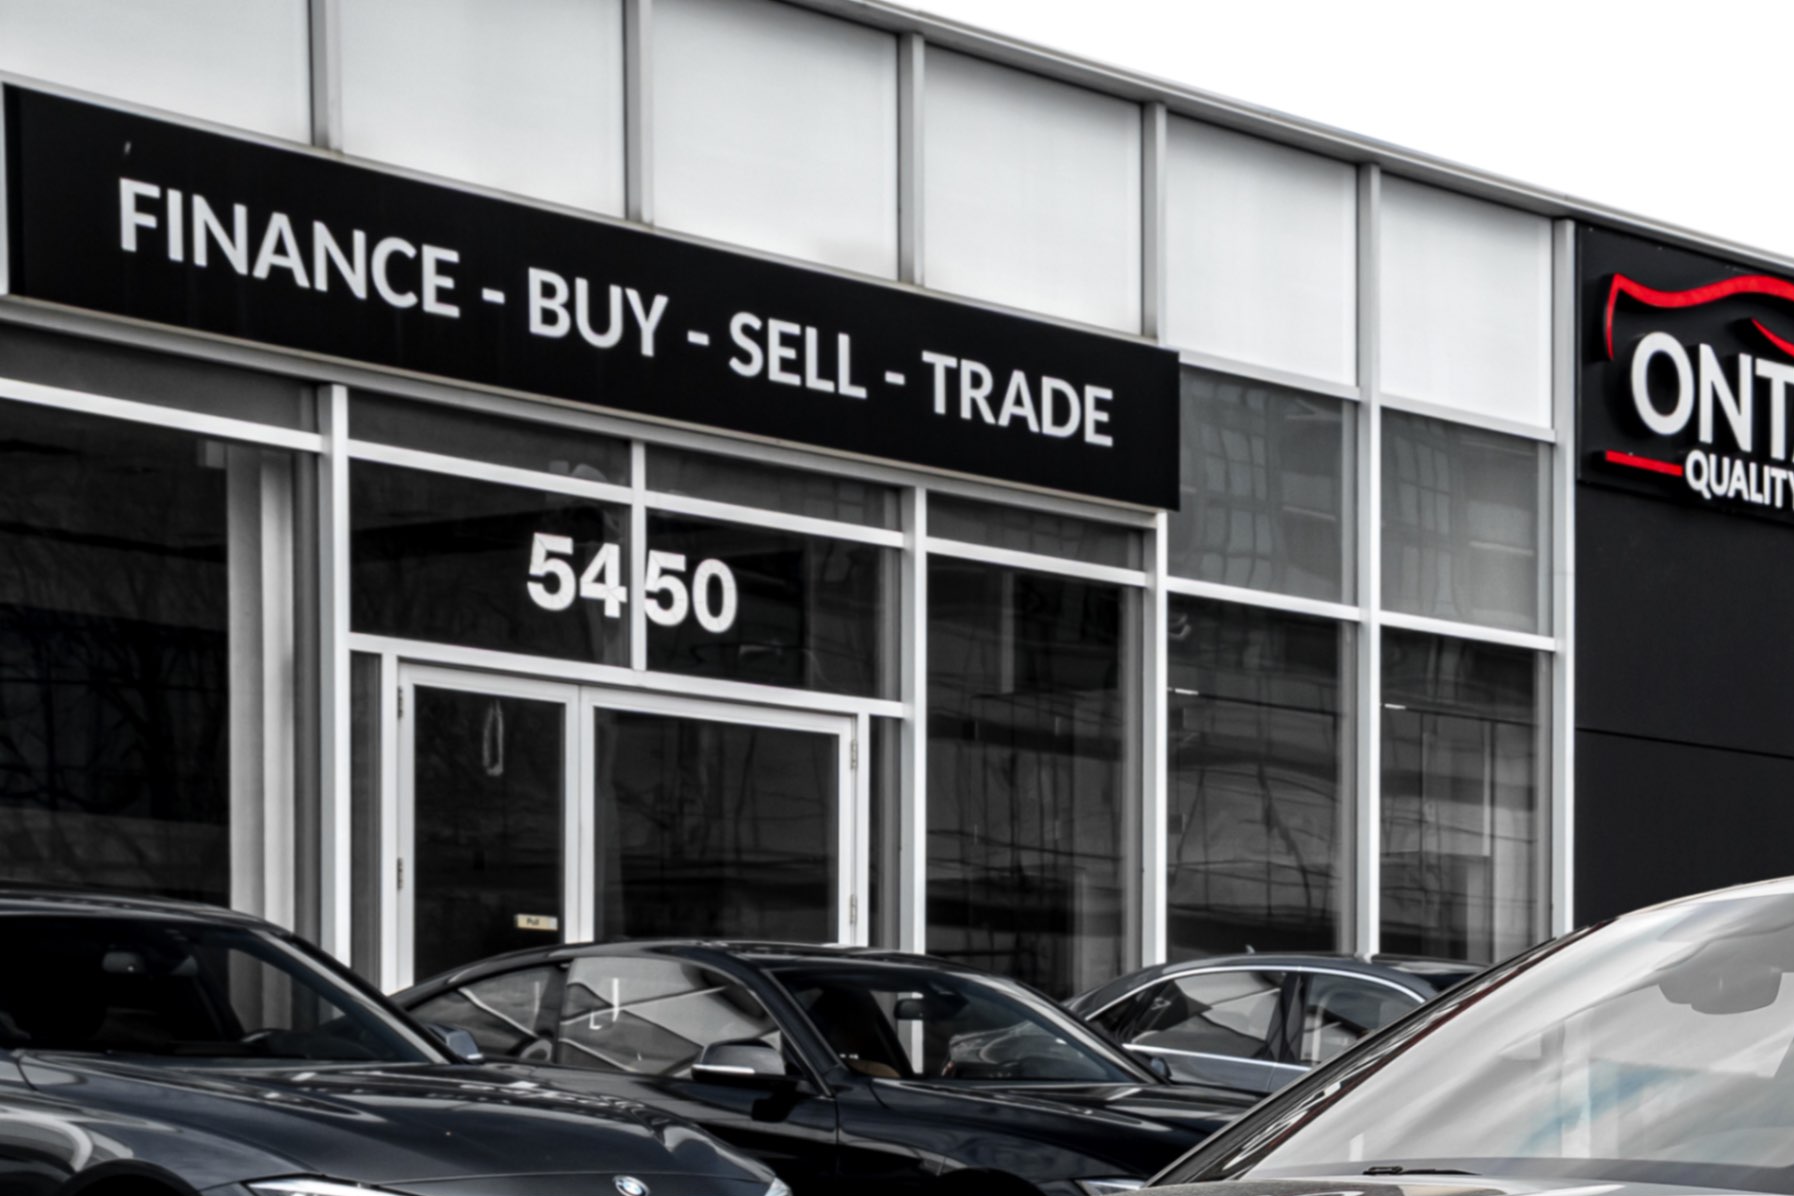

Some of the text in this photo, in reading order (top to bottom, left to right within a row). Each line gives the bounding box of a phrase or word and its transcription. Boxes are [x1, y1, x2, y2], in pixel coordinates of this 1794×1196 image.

[118, 176, 461, 319] FINANCE
[527, 266, 670, 359] BUY
[727, 310, 869, 400] SELL
[920, 349, 1115, 448] TRADE
[526, 531, 739, 635] 5450
